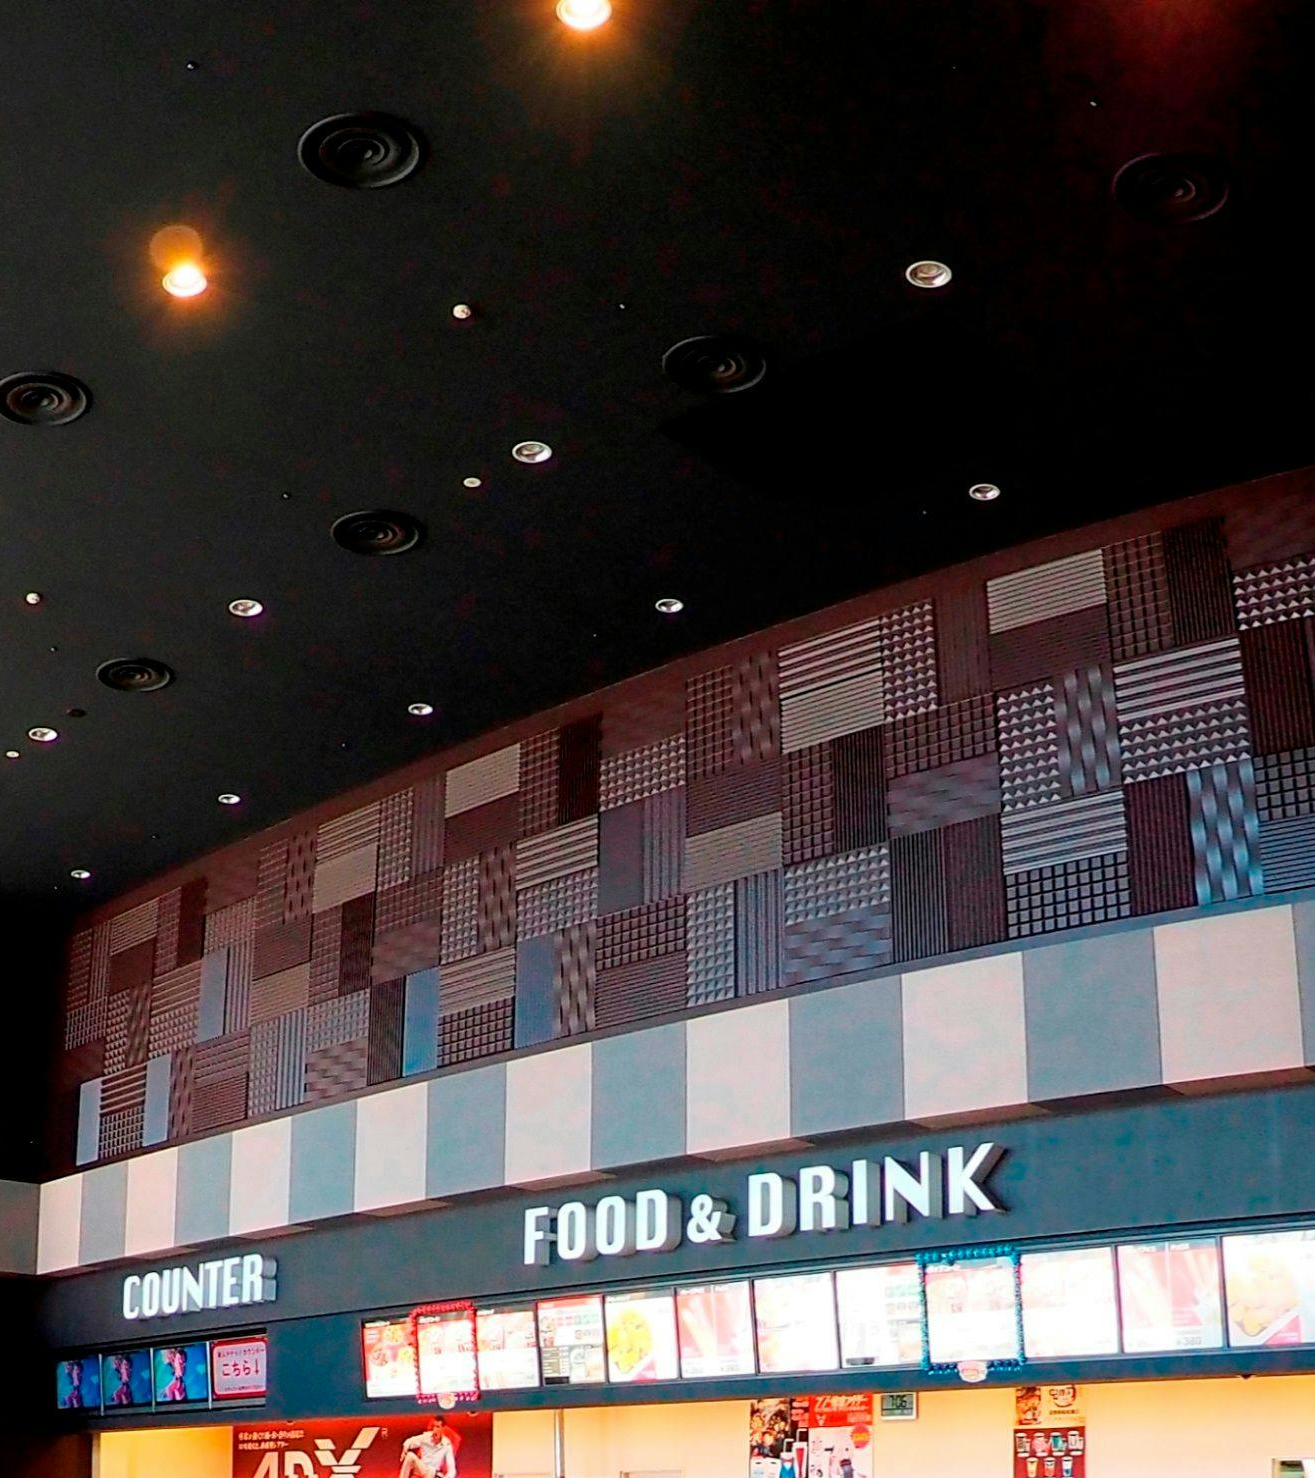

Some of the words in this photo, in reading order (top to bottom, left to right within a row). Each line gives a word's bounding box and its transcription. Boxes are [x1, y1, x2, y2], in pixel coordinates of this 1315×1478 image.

[524, 1189, 669, 1265] FOOD
[687, 1193, 724, 1243] &
[747, 1142, 995, 1238] DRINK
[123, 1254, 265, 1320] COUNTER
[222, 1360, 251, 1377] こちら
